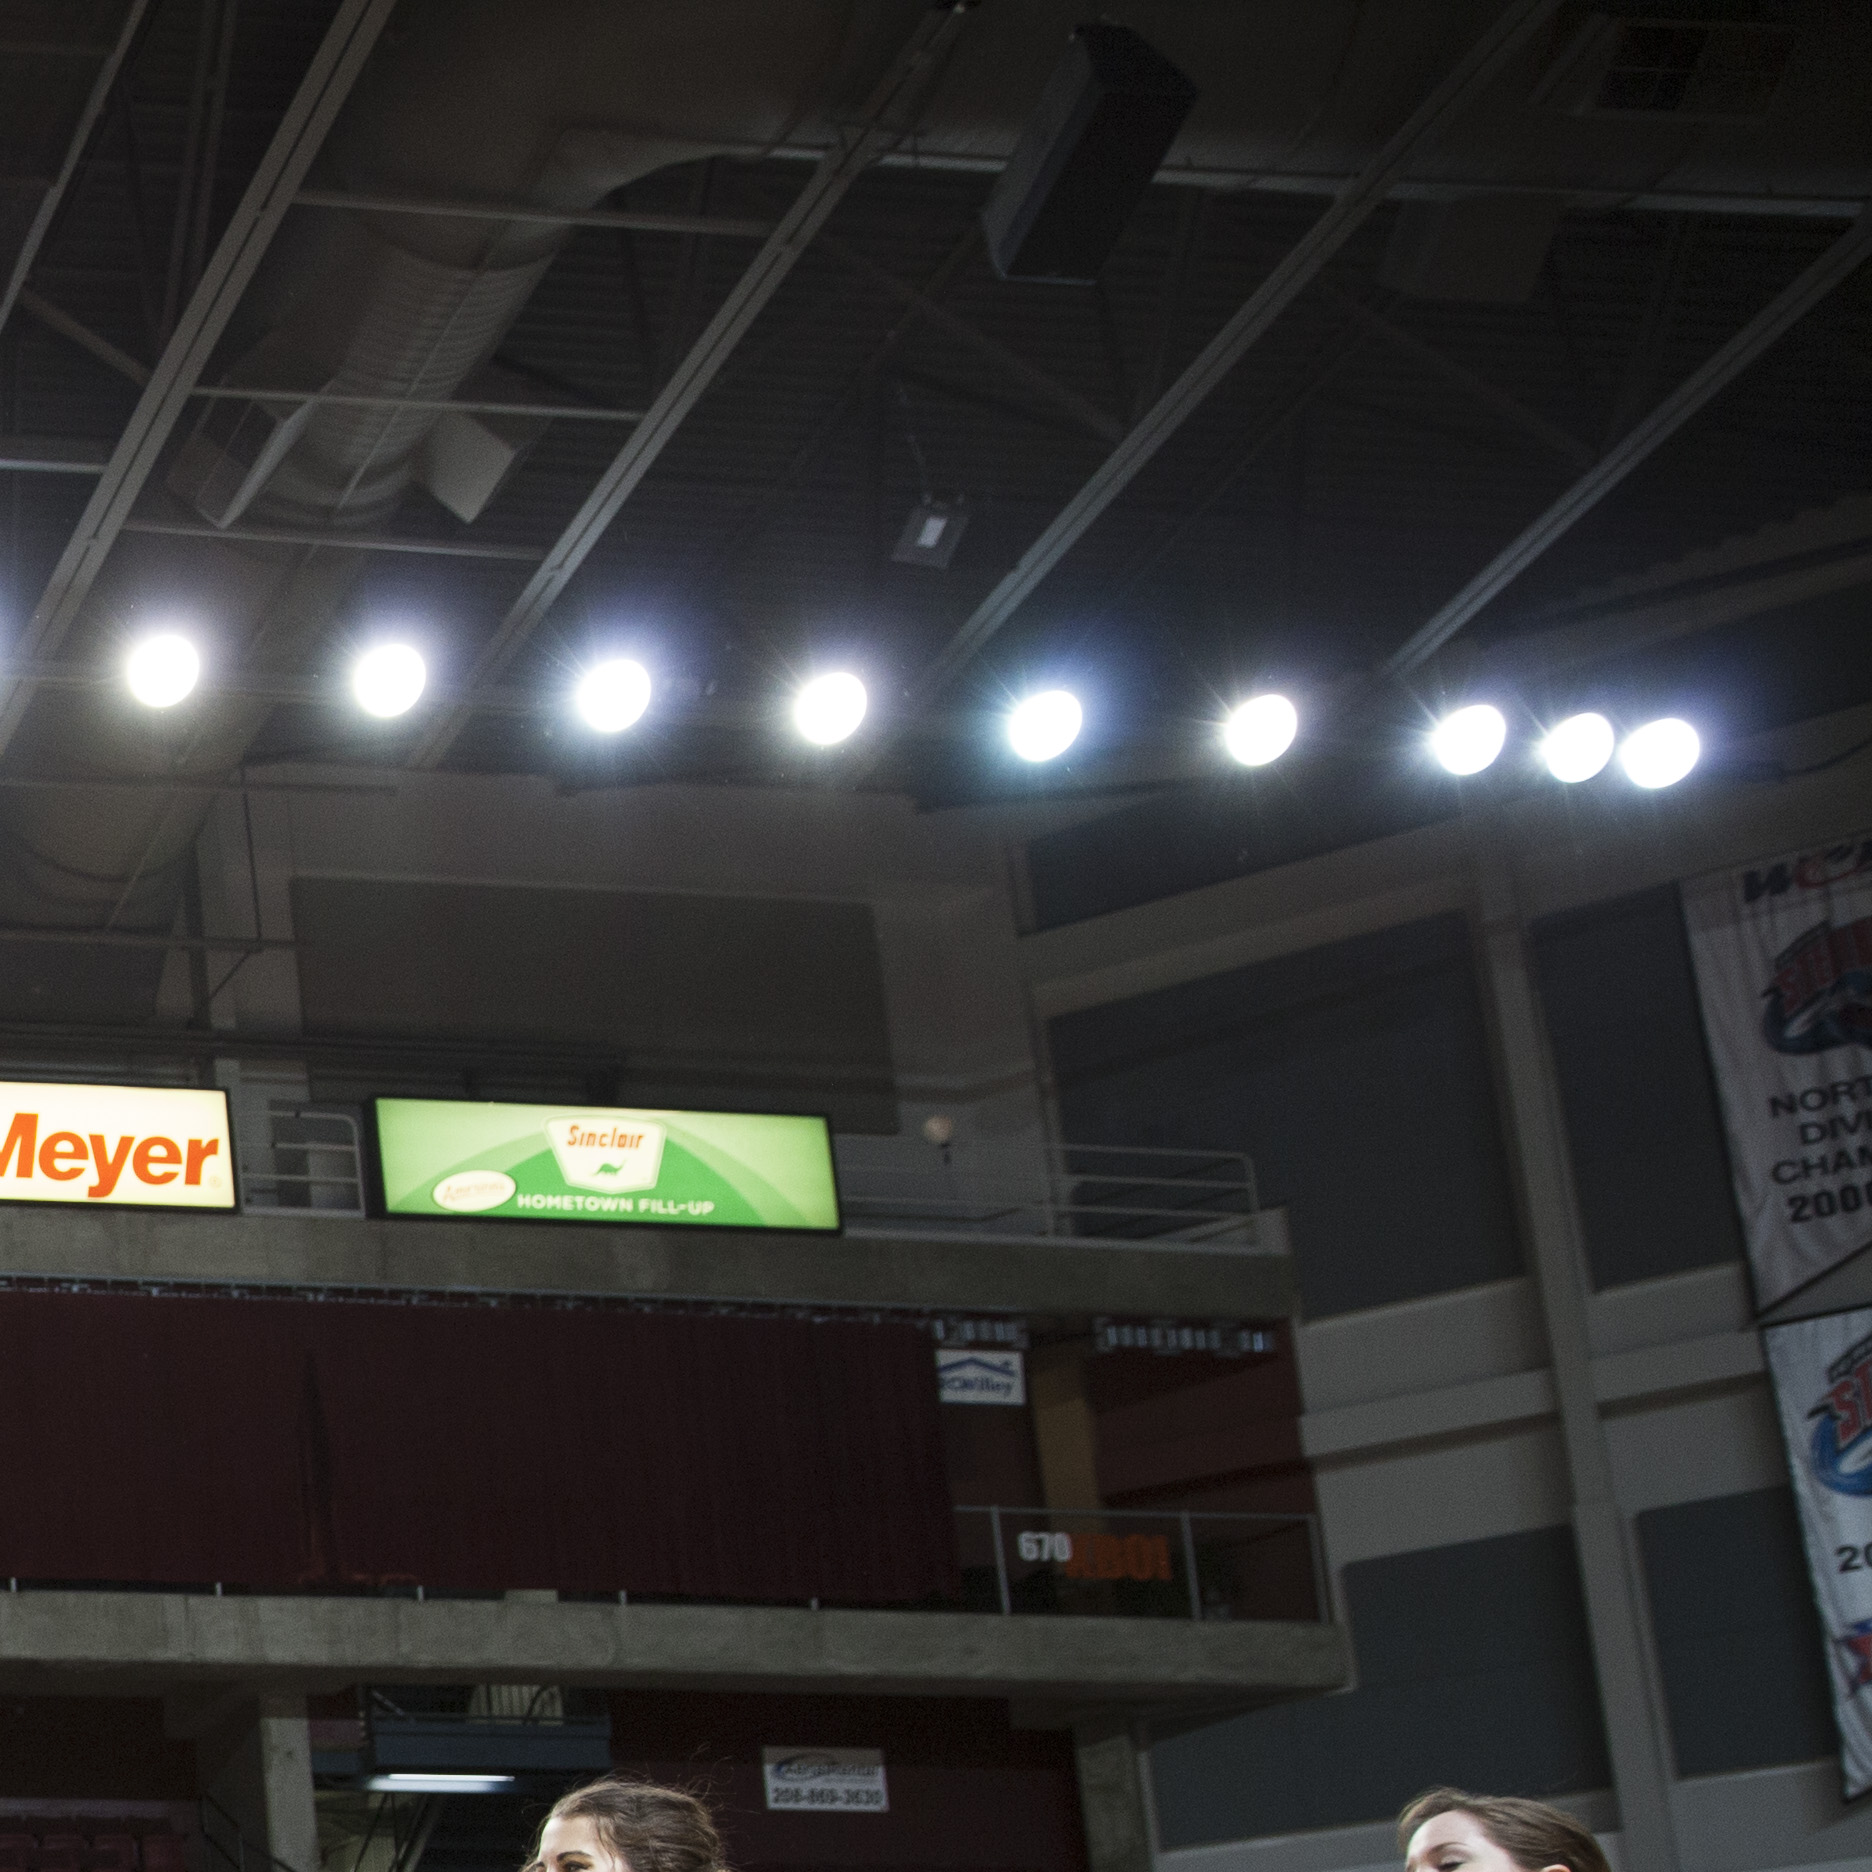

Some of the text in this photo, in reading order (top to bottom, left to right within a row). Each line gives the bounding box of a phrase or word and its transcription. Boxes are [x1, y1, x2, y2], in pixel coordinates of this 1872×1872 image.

[517, 1193, 634, 1214] HOMETOWN
[639, 1197, 715, 1216] FILL-UP
[1017, 1530, 1073, 1562] 670
